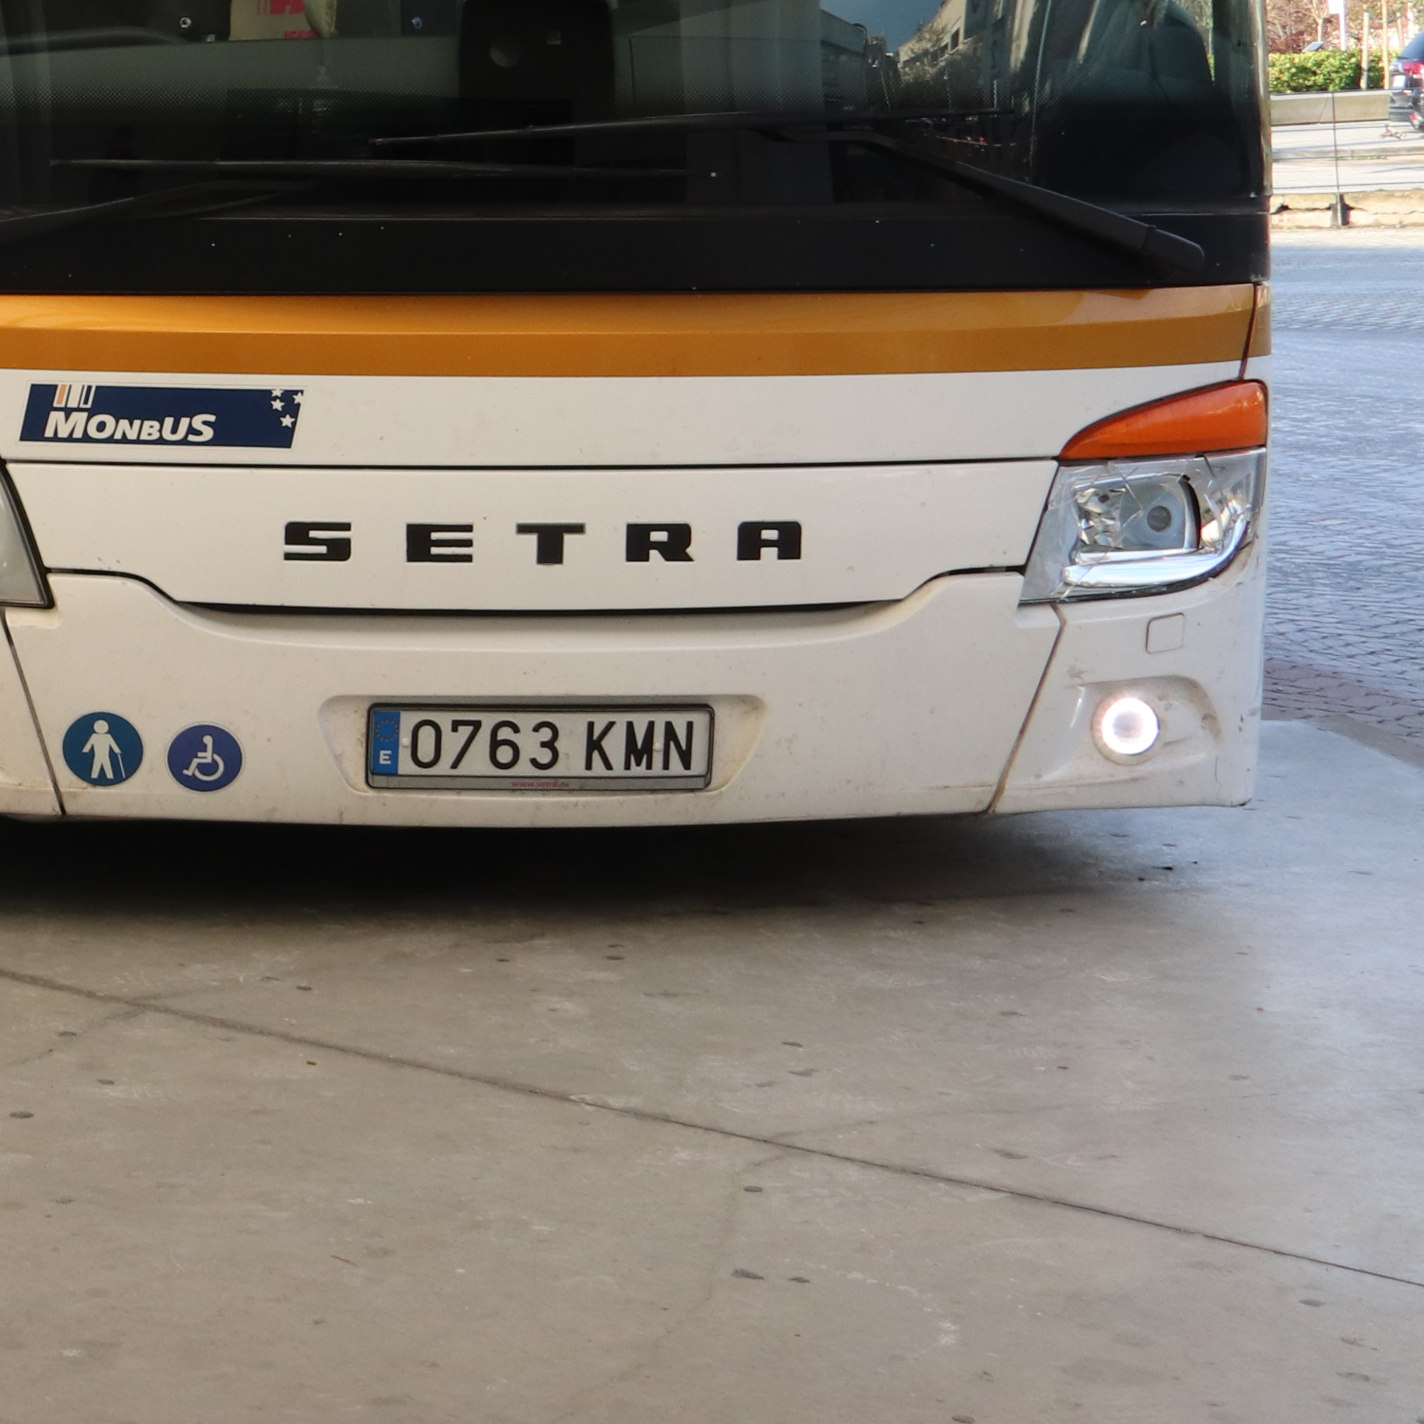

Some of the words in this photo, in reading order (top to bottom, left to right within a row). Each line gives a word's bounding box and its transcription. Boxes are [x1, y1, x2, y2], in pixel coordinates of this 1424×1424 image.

[284, 521, 802, 565] SETRA
[379, 750, 392, 764] E
[410, 719, 560, 770] 0763
[584, 720, 693, 771] KMN
